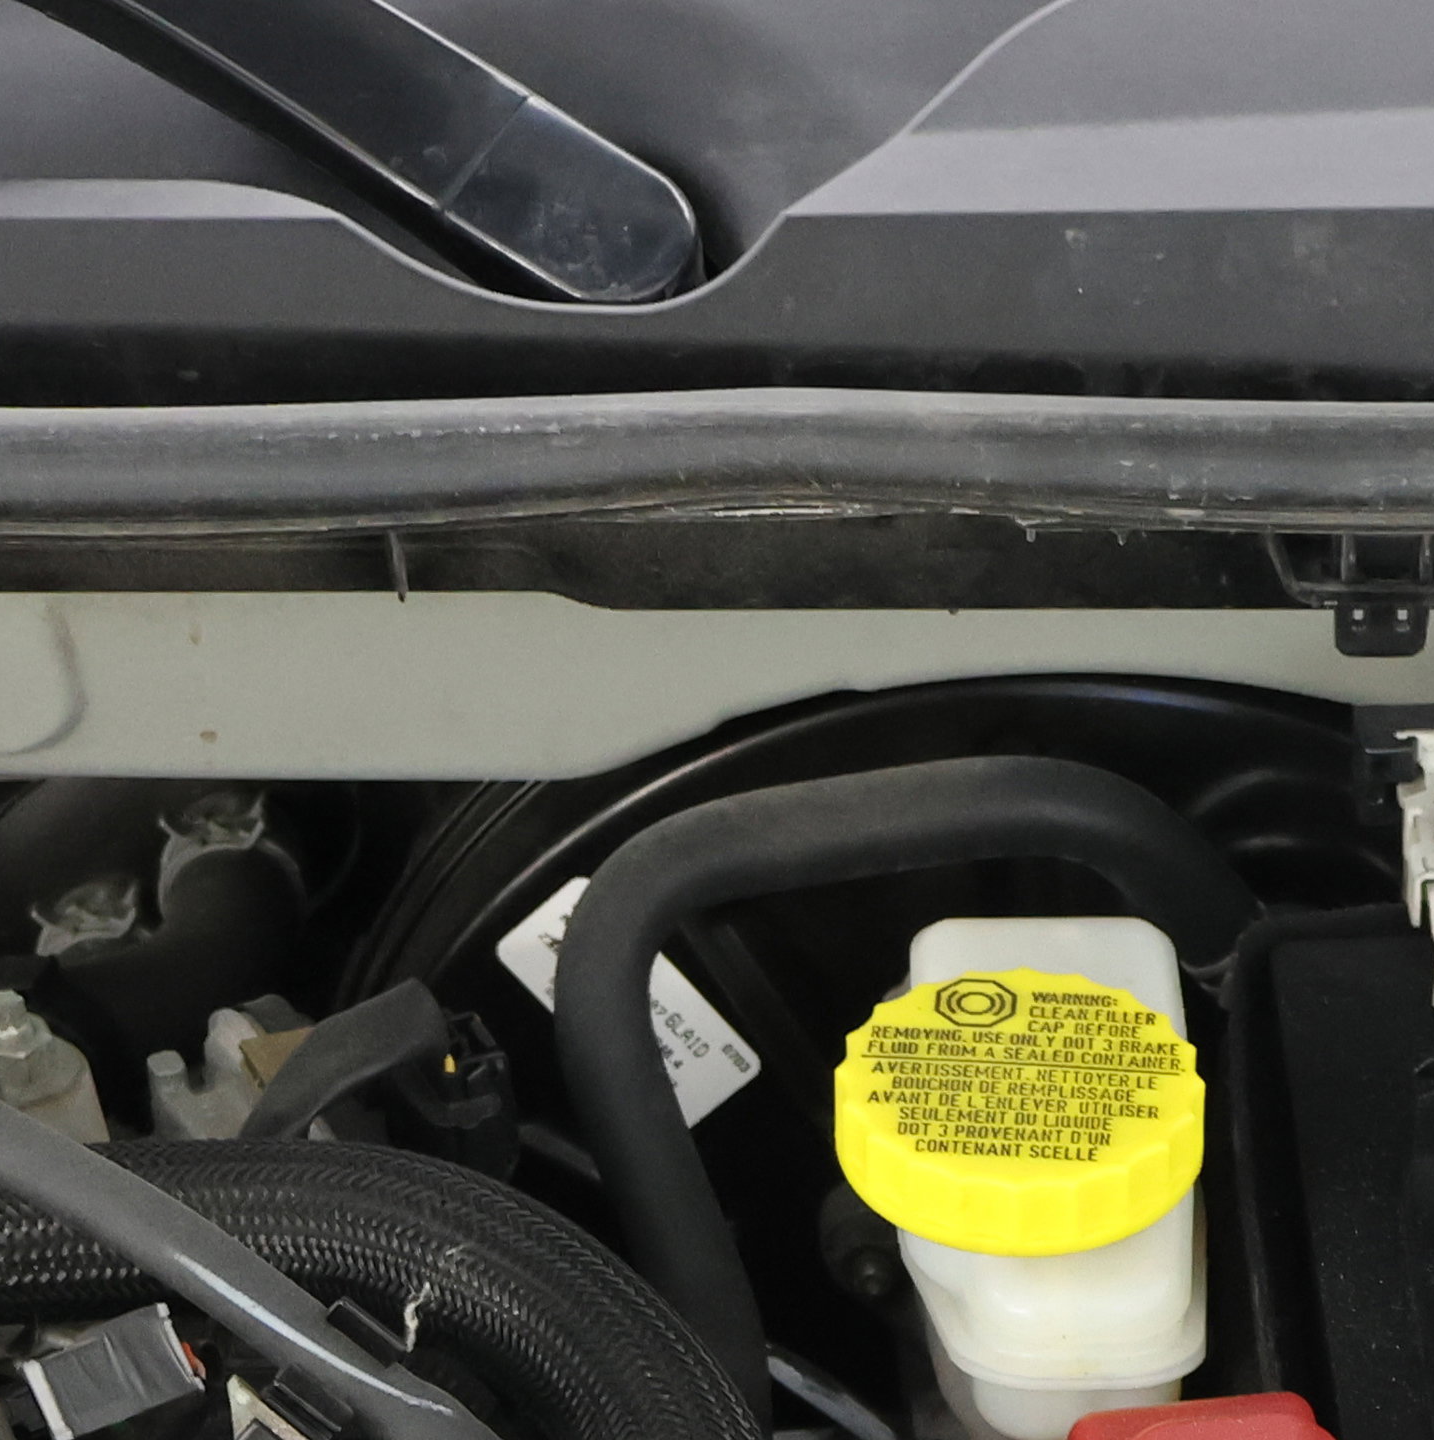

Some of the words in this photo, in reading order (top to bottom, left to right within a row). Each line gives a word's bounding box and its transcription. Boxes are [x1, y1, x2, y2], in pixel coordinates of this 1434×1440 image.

[1031, 990, 1119, 1008] WARNING:
[1028, 1005, 1089, 1022] CLEAN
[1093, 1008, 1157, 1027] FILLER
[1026, 1020, 1066, 1035] CAP
[1073, 1022, 1141, 1039] BEFORE
[972, 1030, 1006, 1045] USE
[1009, 1033, 1056, 1049] ONLY
[1062, 1035, 1095, 1051] DOT
[1102, 1038, 1114, 1053] 3
[1118, 1040, 1180, 1057] BRAKE
[866, 1040, 918, 1056] FLUID
[926, 1042, 976, 1058] FROM
[984, 1045, 996, 1060] A
[1003, 1046, 1075, 1063] SEALED
[1081, 1049, 1186, 1073] CONTAINER.
[891, 1076, 974, 1093] BOUCHON
[979, 1078, 1001, 1095] DE
[1006, 1081, 1136, 1103] REMPLISSAGE
[1036, 1068, 1129, 1088] NETTOYER
[1136, 1075, 1158, 1091] LE
[866, 1090, 931, 1107] AVANT
[938, 1093, 962, 1108] DE
[1078, 1100, 1160, 1120] UTILISER
[898, 1106, 1008, 1124] SEULEMENT
[1014, 1111, 1038, 1126] DU
[1043, 1113, 1113, 1132] LIQUIDE
[896, 1121, 930, 1137] DOT
[937, 1123, 949, 1138] 3
[953, 1124, 1063, 1143] PROVENANT
[1069, 1129, 1111, 1146] D'UN
[914, 1138, 1023, 1159] CONTENANT
